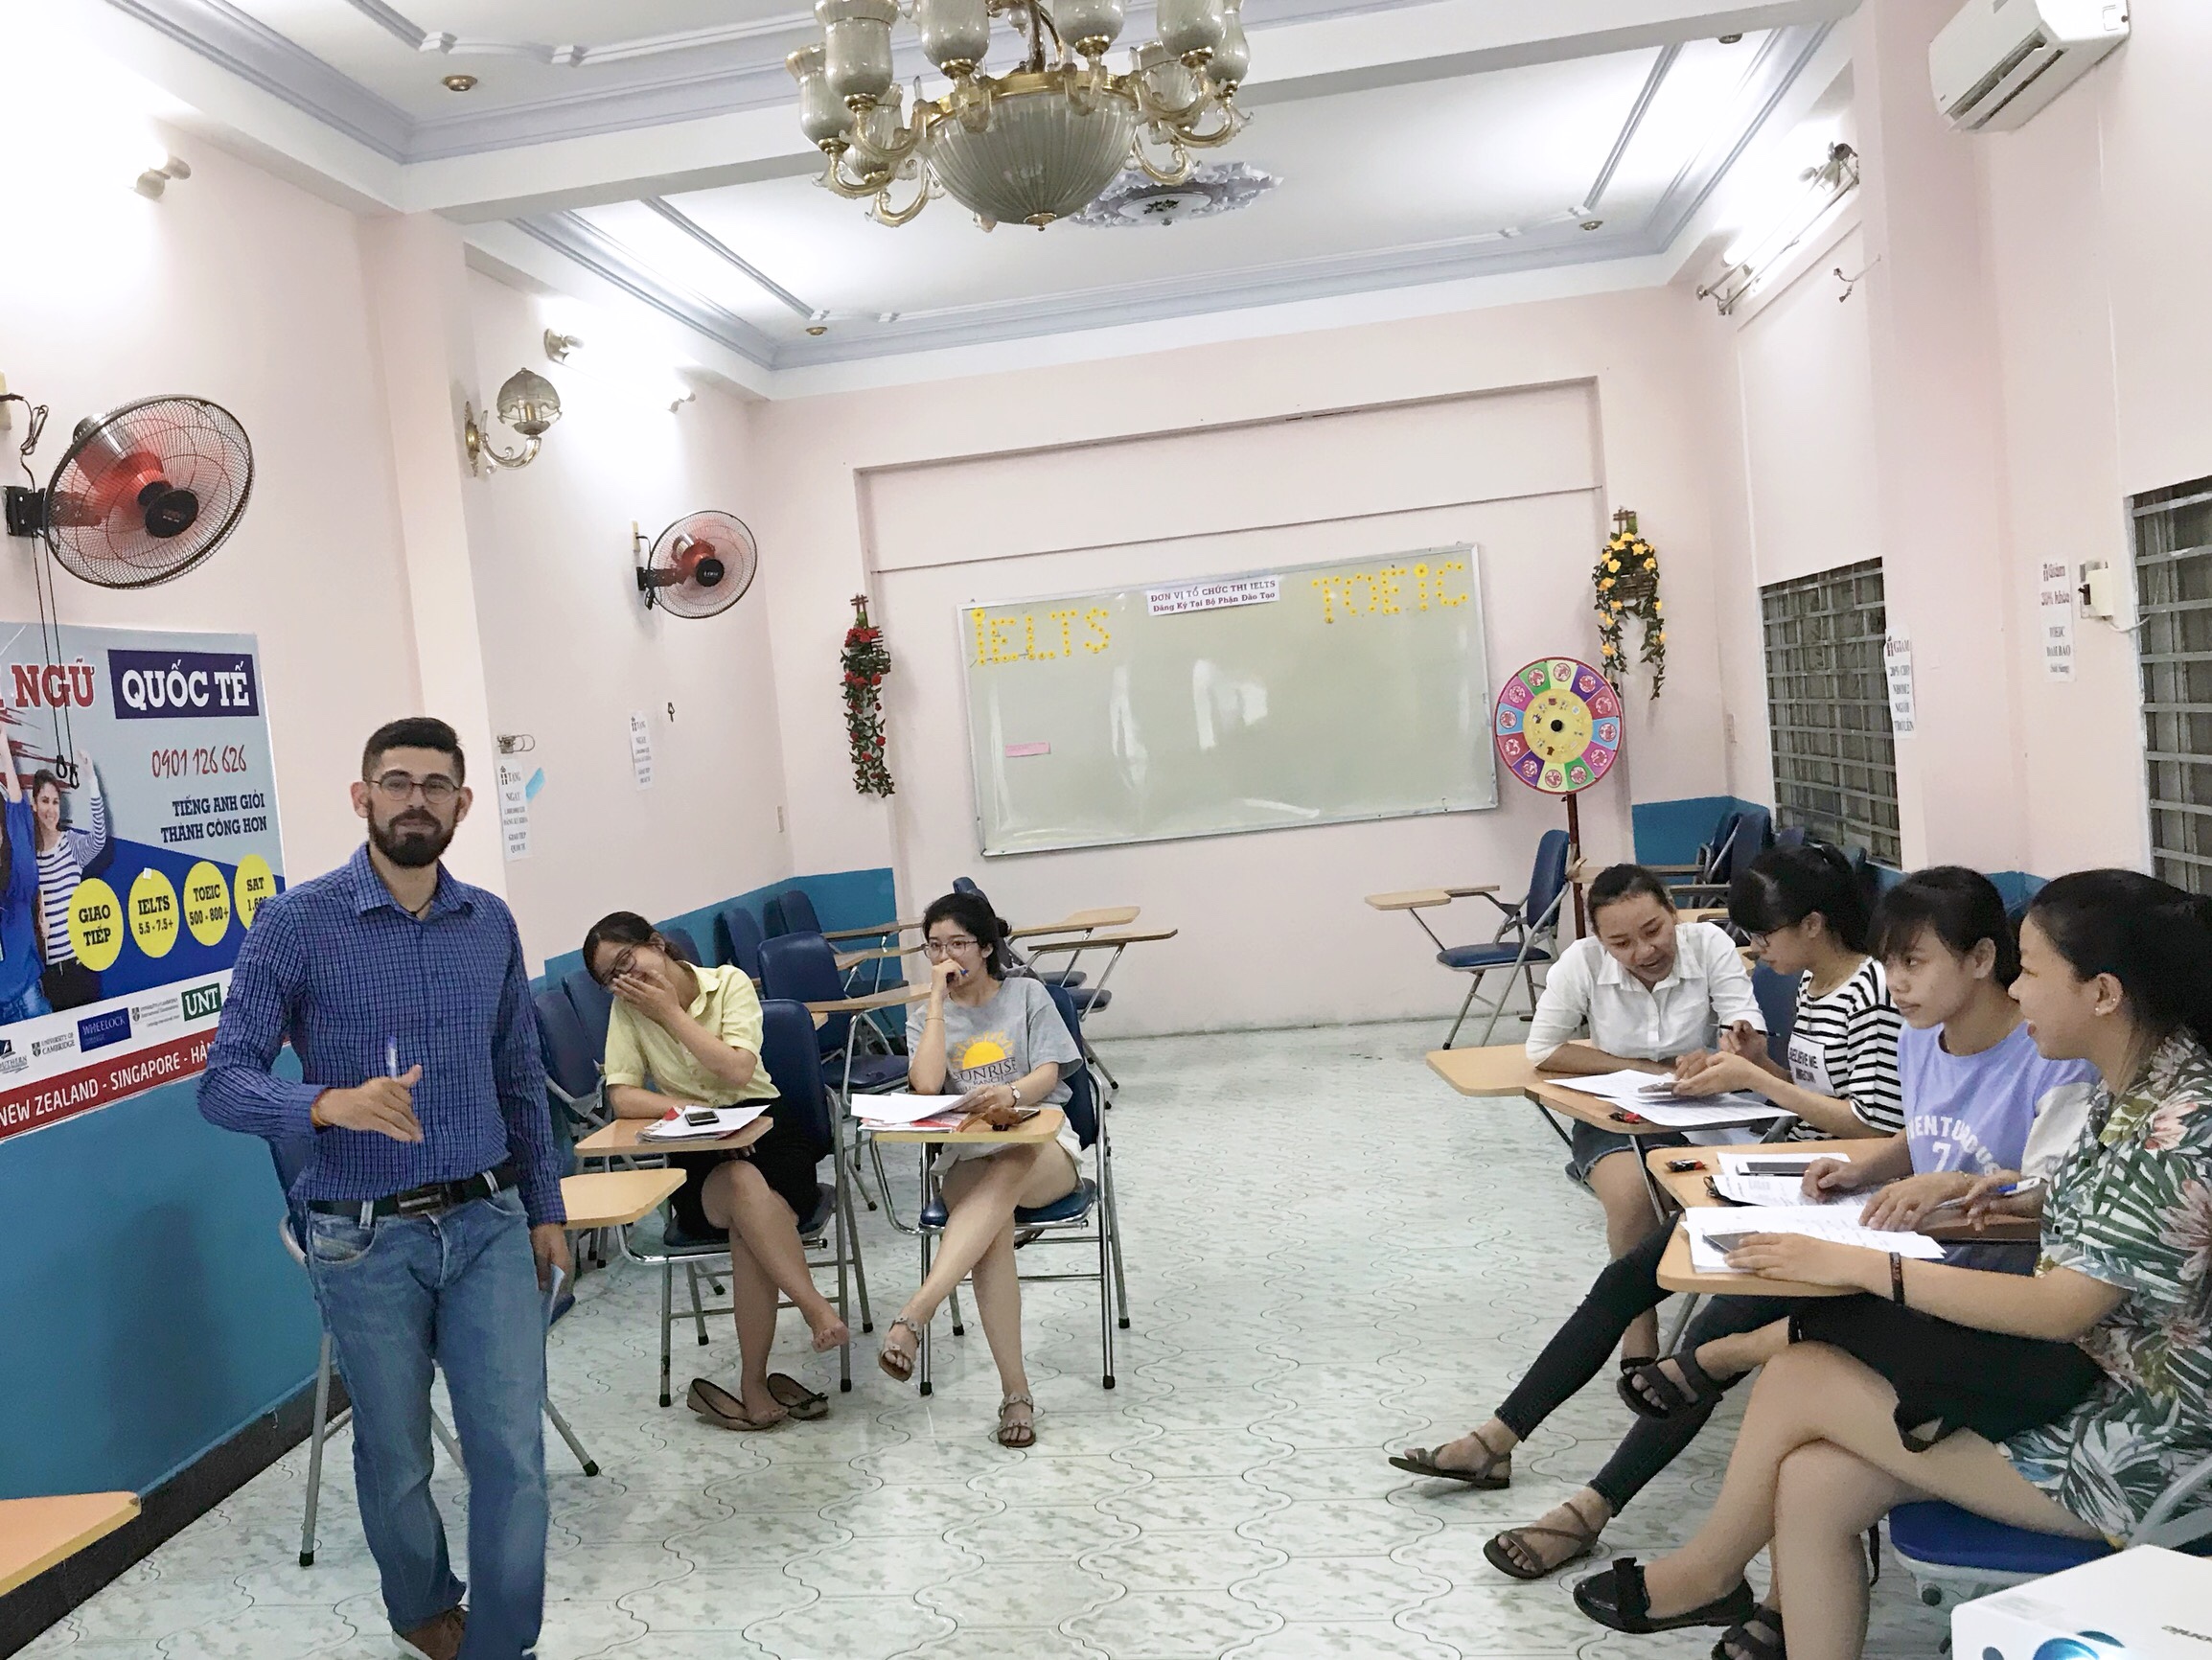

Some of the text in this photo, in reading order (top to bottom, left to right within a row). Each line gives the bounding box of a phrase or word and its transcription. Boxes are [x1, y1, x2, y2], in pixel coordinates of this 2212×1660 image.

[1231, 583, 1247, 592] THI
[1250, 580, 1276, 590] IELTS
[971, 607, 1111, 665] IELTS
[12, 658, 250, 710] NGỮ QUỐC TẾ
[152, 745, 246, 778] 0901 126 626
[172, 789, 265, 817] TIẾNG ANH GIỎI
[193, 885, 220, 902] TOEIC
[246, 877, 265, 891] SAT
[79, 905, 110, 924] GIAO
[138, 895, 171, 915] IELTS
[139, 922, 150, 934] 5.5
[156, 917, 173, 932] 7.5+
[190, 911, 203, 926] 500
[210, 908, 229, 922] 800+
[83, 923, 111, 946] TIẾP
[185, 987, 218, 1016] UNT
[82, 1015, 126, 1036] WHEELOCK
[41, 1034, 64, 1047] UNIVERSITY
[42, 1039, 75, 1054] CAMBRIDGE
[954, 1060, 1017, 1081] SUNRISE
[35, 1078, 99, 1116] ZEALAND
[110, 1052, 181, 1091] SINGAPORE
